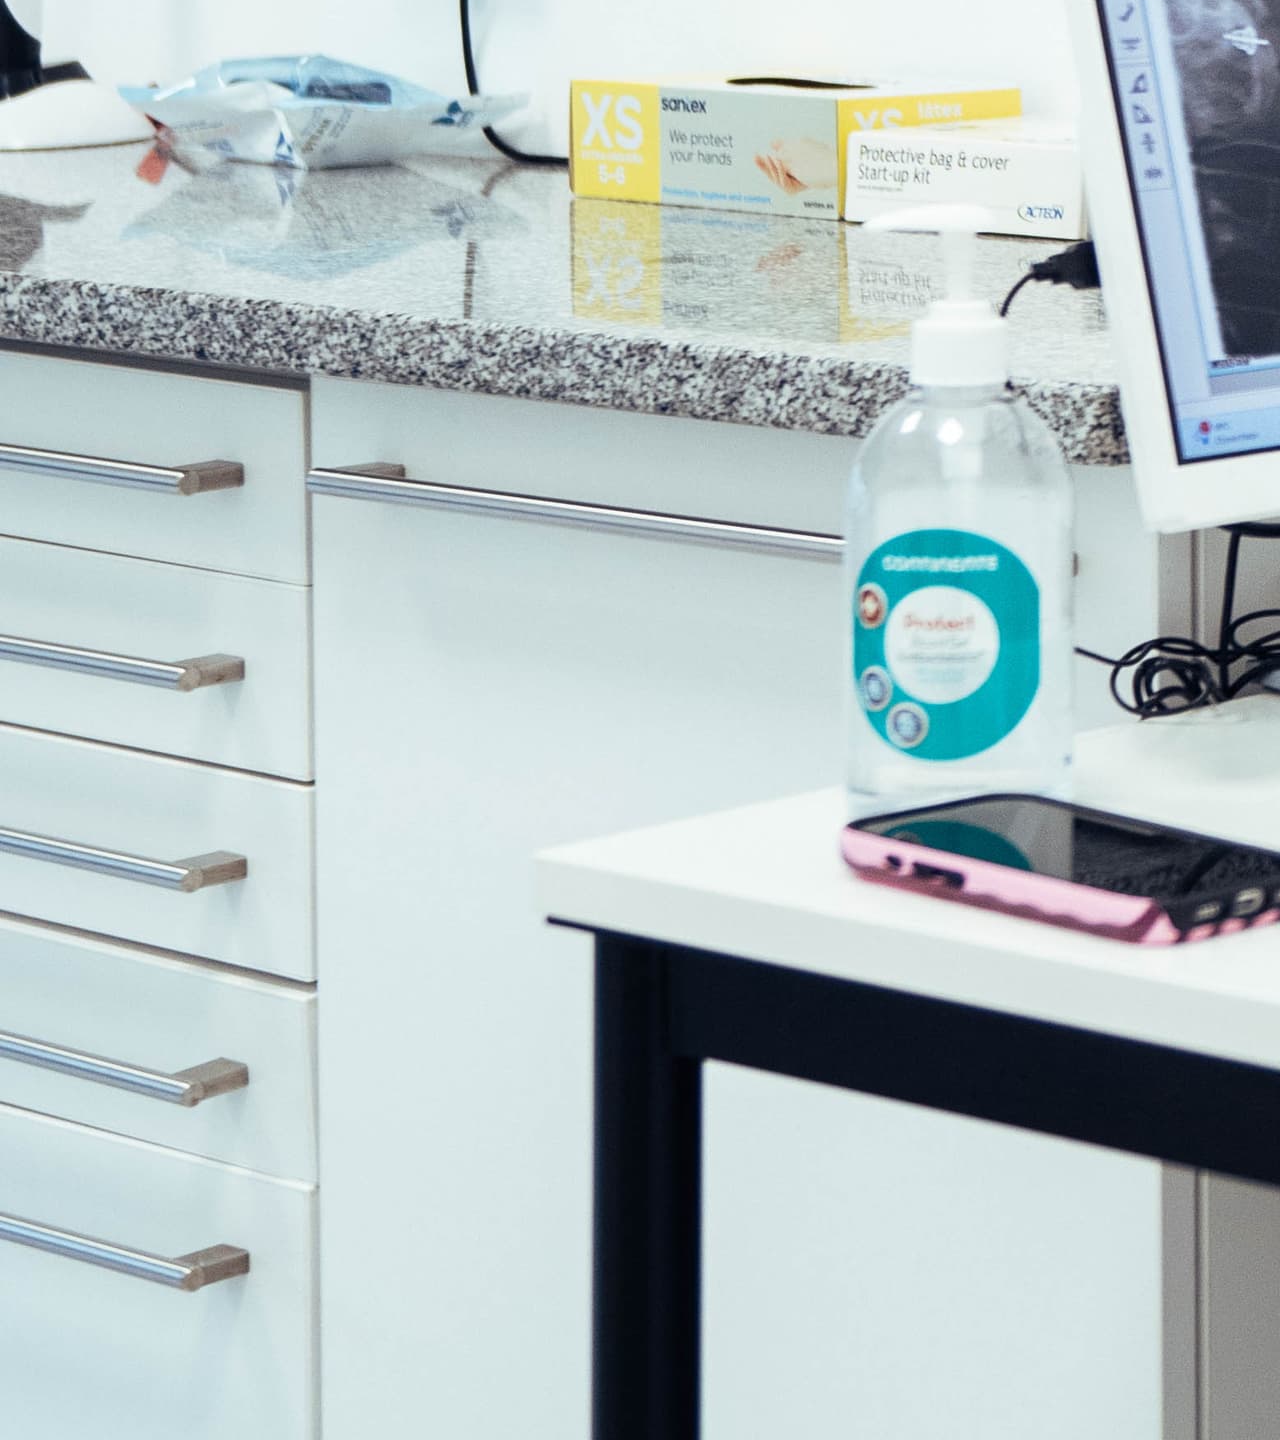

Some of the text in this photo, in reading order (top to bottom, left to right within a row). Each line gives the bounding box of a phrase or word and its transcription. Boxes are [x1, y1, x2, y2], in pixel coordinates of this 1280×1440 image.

[580, 91, 644, 151] XS
[669, 129, 734, 150] We protect
[669, 149, 733, 167] your hands
[859, 143, 1010, 171] Protective bag & cover
[858, 164, 931, 186] Start-up kit
